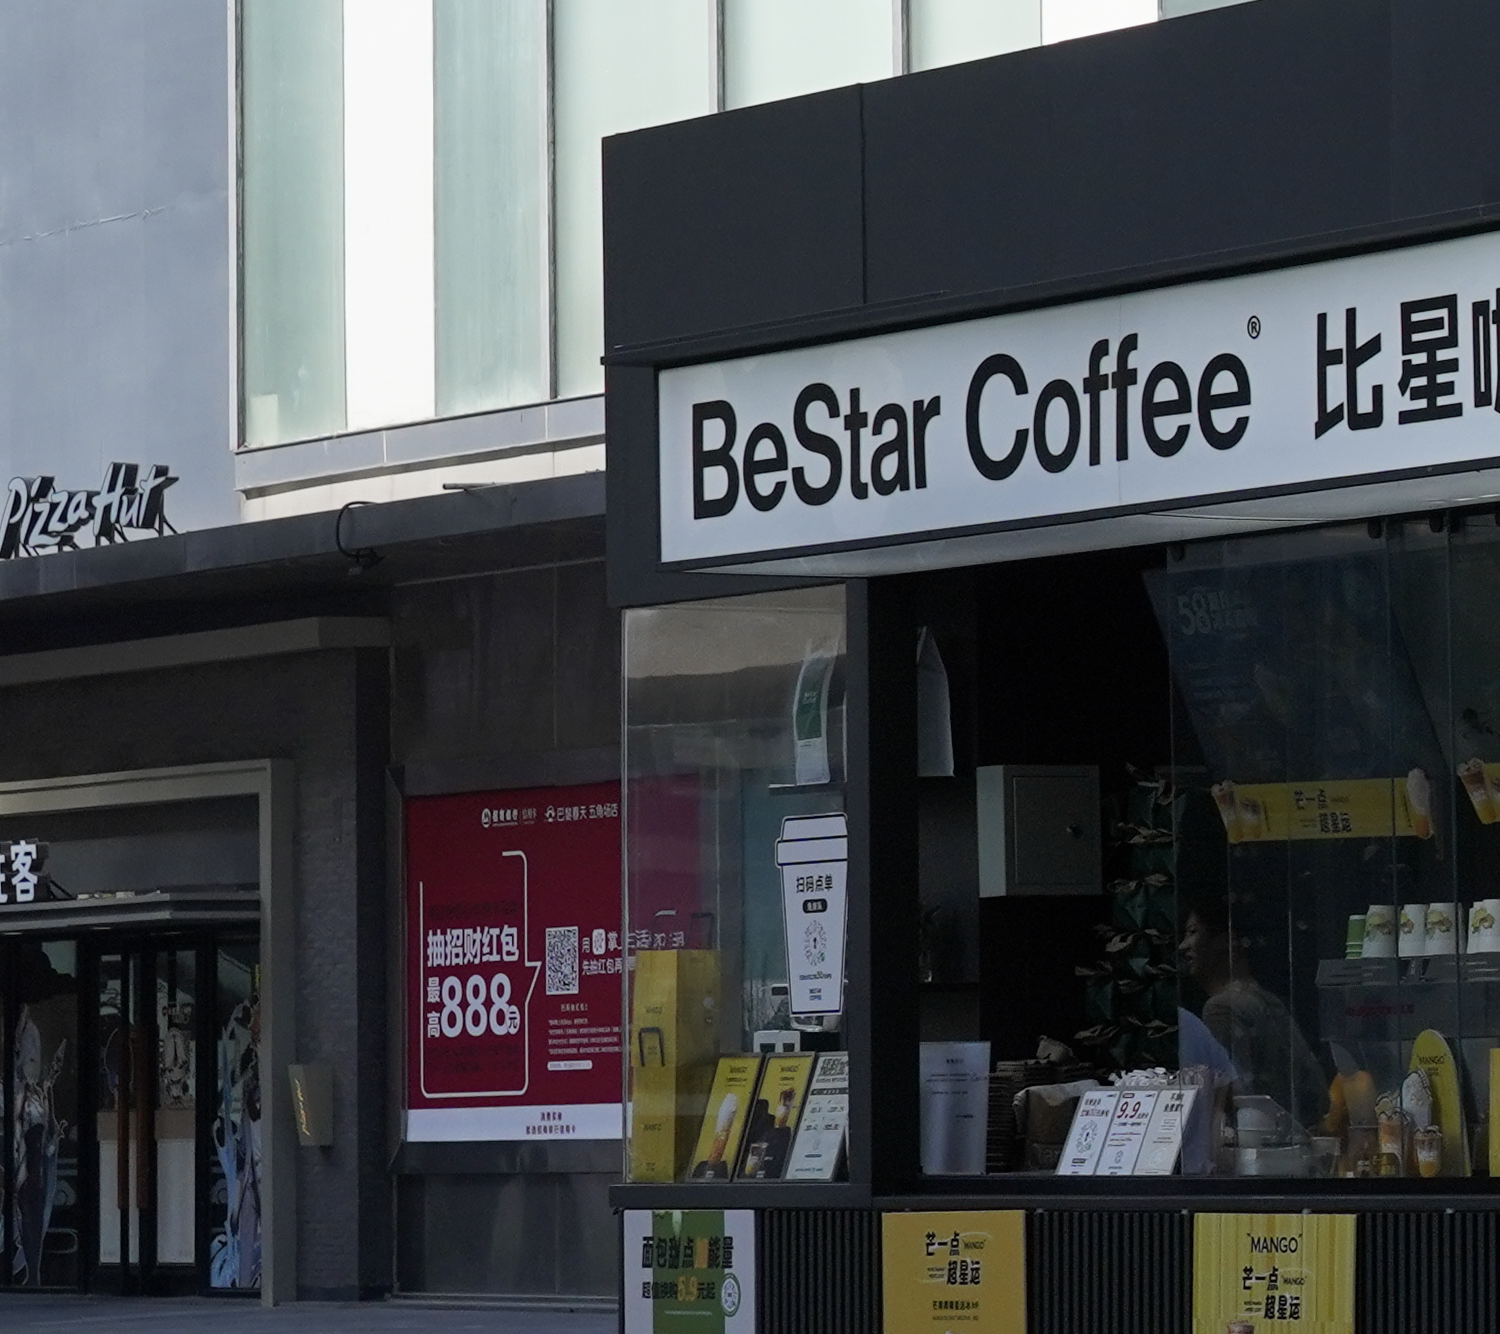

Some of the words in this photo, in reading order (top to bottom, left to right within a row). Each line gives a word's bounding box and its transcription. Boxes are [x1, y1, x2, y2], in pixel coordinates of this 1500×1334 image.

[692, 382, 941, 519] BeStar
[965, 332, 1251, 481] Coffee
[0, 476, 91, 558] Pizza
[92, 462, 167, 537] Hut
[427, 925, 519, 966] 抽招财红包
[441, 973, 512, 1038] 888
[1117, 1101, 1141, 1119] 9.9
[926, 1231, 960, 1256] 芒一点
[1247, 1233, 1303, 1254] "MANGO"
[947, 1260, 980, 1285] 超星运
[1243, 1266, 1278, 1291] 芒一点
[1264, 1295, 1300, 1319] 超星运
